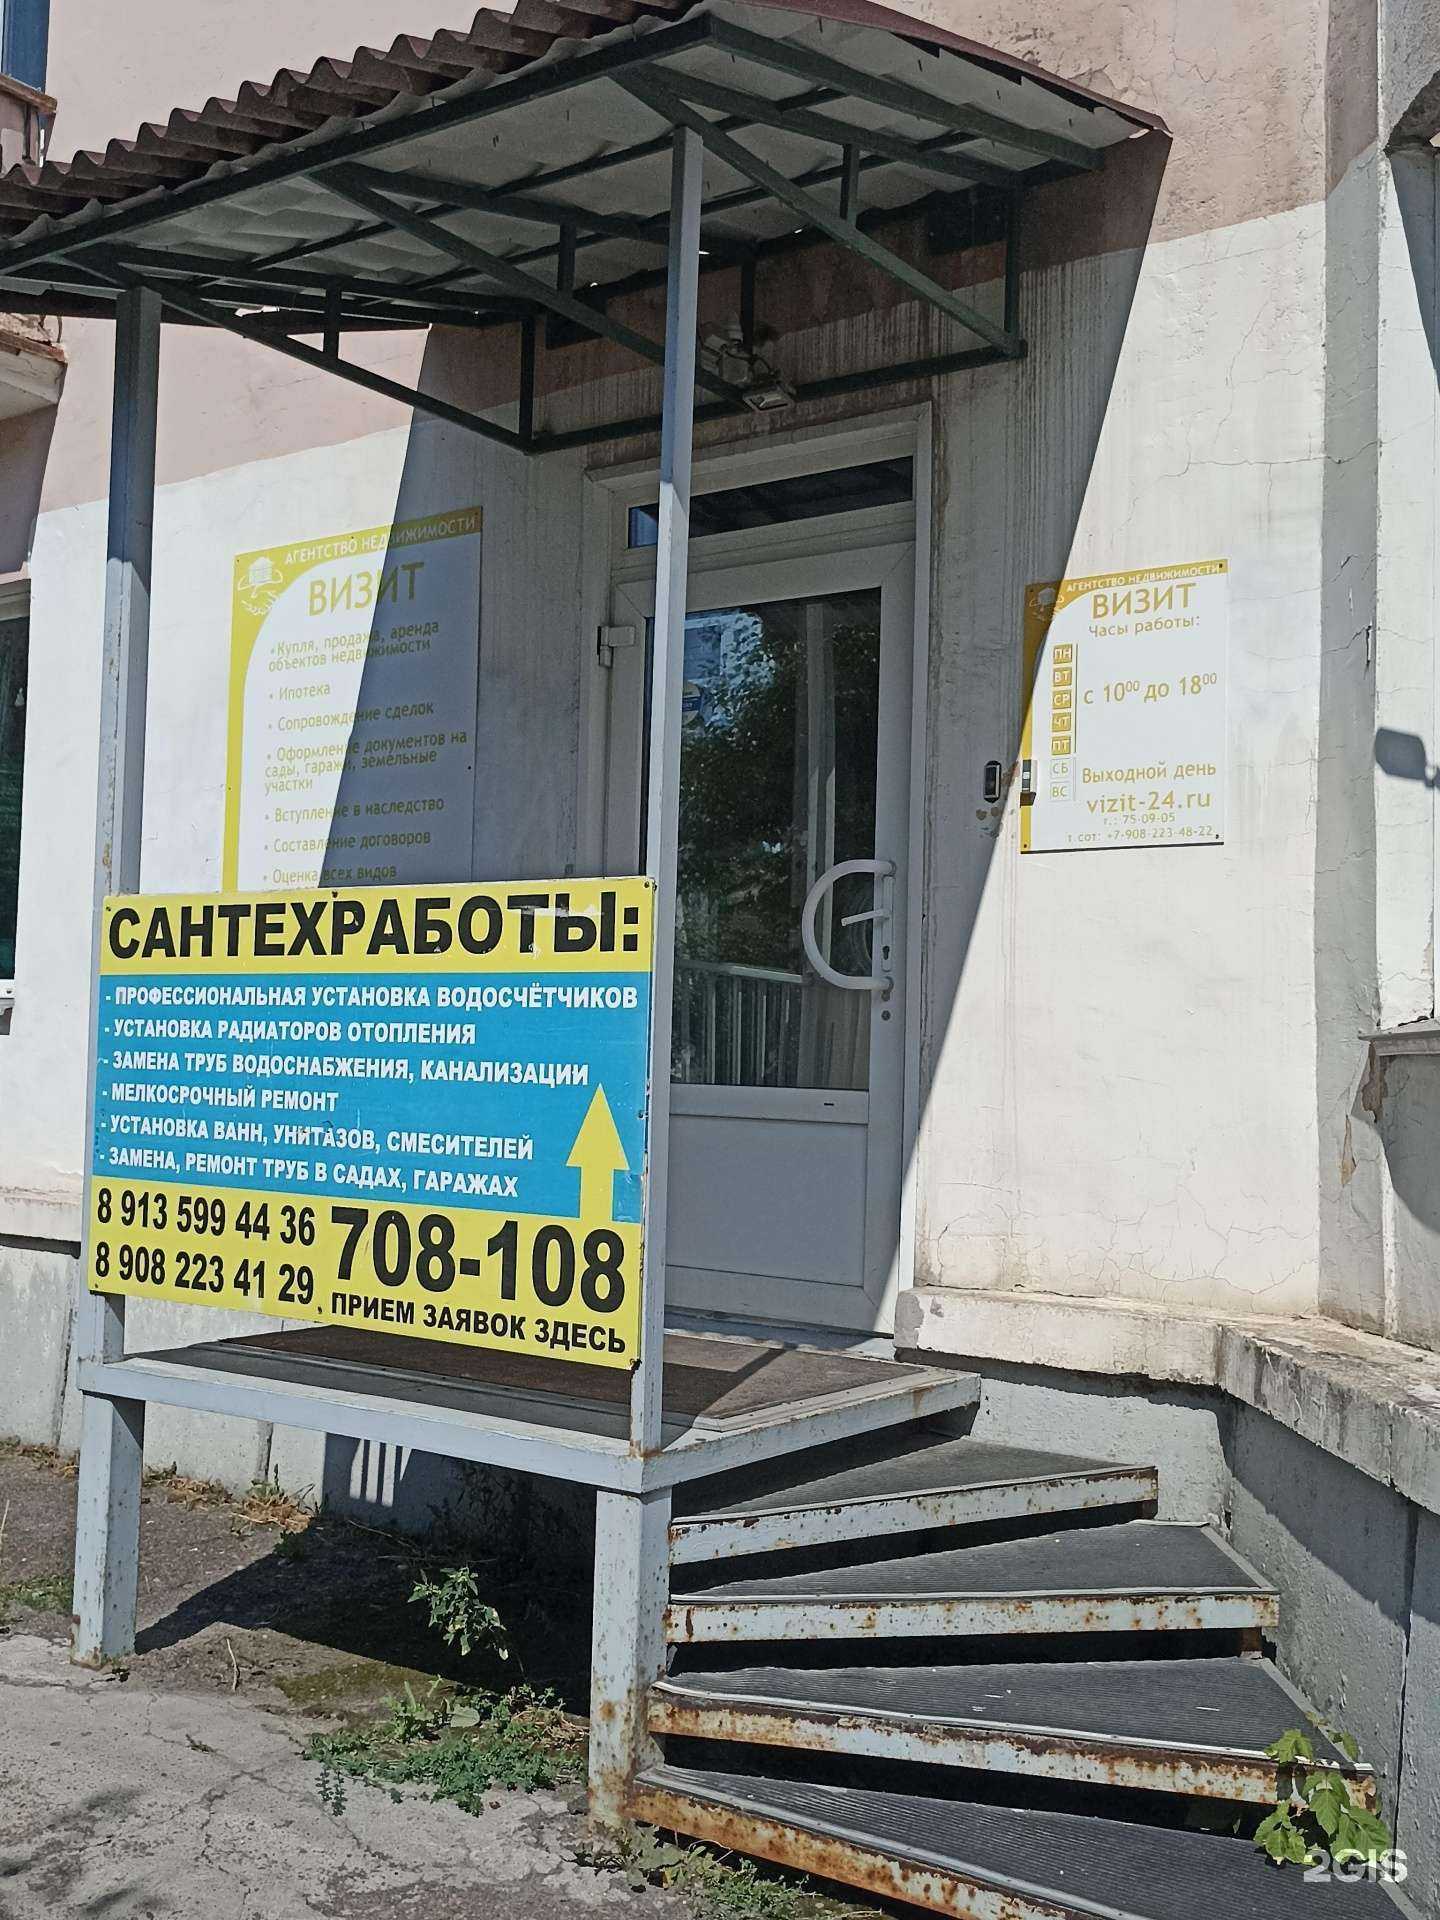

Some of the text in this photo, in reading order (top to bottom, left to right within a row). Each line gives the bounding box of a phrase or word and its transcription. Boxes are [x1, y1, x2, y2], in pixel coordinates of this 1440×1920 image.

[284, 516, 476, 565] АГЕНТСТВО НЕДВИЖИМОСТИ
[308, 561, 425, 616] ВИЗИТ
[1067, 564, 1220, 592] АГЕНТСТВО НЕДВИЖИМОСТИ
[1092, 583, 1196, 619] ВИЗИТ
[278, 621, 439, 656] Купля, продажа, аренда
[1089, 616, 1200, 637] Часы работы:
[268, 639, 431, 672] объектов недвижимости
[1054, 649, 1072, 659] ПН
[1054, 670, 1071, 682] ВТ
[279, 683, 331, 702] Ипотека
[1054, 695, 1070, 706] СР
[1144, 682, 1169, 702] до
[278, 702, 434, 732] Сопровождение сделок
[1053, 716, 1070, 727] ЧТ
[277, 731, 467, 764] Оформление документов на
[1052, 741, 1070, 751] ПТ
[264, 750, 437, 778] сады, гаражи, земельные
[1053, 762, 1069, 774] СБ
[1082, 762, 1216, 783] Выходной день
[264, 778, 312, 794] участки
[1052, 785, 1067, 798] ВС
[274, 798, 444, 823] Вступление в наследство
[1087, 791, 1211, 814] vizit-24.ru
[274, 832, 431, 854] Составление договоров
[272, 864, 396, 885] Оценка всех видов
[109, 891, 639, 959] САНТЕХРАБОТЫ:
[311, 986, 430, 1007] УСТАНОВКА
[438, 984, 638, 1009] ВОДОСЧЁТЧИКОВ
[114, 1019, 212, 1039] УСТАНОВКА
[217, 1020, 342, 1042] РАДИАТОРОВ
[347, 1022, 475, 1044] ОТОПЛЕНИЯ
[112, 1051, 180, 1071] ЗАМЕНА
[185, 1053, 227, 1073] ТРУБ
[232, 1055, 414, 1082] ВОДОСНАБЖЕНИЯ,
[420, 1060, 589, 1088] КАНАЛИЗАЦИИ
[262, 1090, 338, 1112] РЕМОНТ
[110, 1114, 209, 1137] УСТАНОВКА
[214, 1120, 268, 1144] ВАНН,
[274, 1124, 381, 1152] УНИТАЗОВ,
[387, 1127, 534, 1160] СМЕСИТЕЛЕЙ
[109, 1147, 180, 1172] ЗАМЕНА,
[186, 1154, 257, 1176] РЕМОНТ
[263, 1159, 310, 1180] ТРУБ
[315, 1161, 328, 1181] В
[333, 1164, 407, 1192] САДАХ,
[414, 1171, 518, 1197] ГАРАЖАХ
[97, 1190, 315, 1245] 8 913 599 44 36
[331, 1206, 626, 1313] 708-108
[96, 1242, 314, 1304] 8 908 223 41 29
[331, 1293, 626, 1353] ПРИЕМ ЗАЯВОК ЗДЕСЬ
